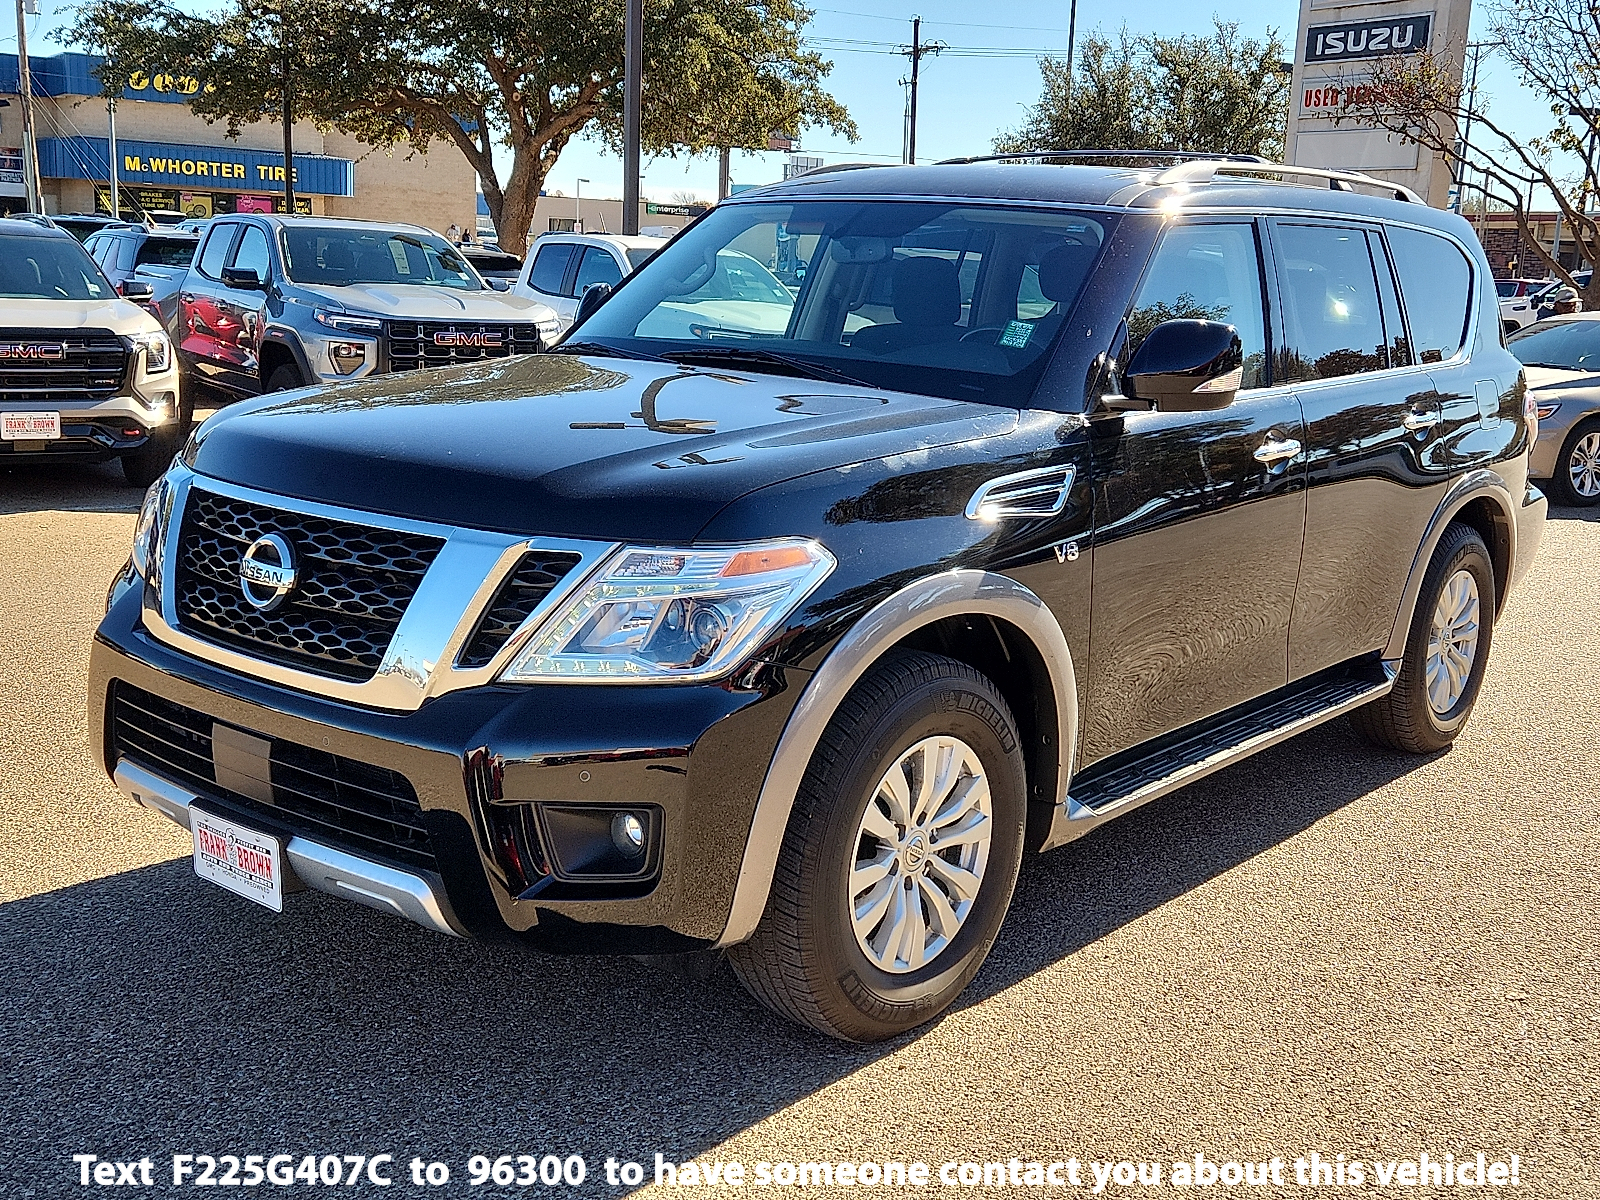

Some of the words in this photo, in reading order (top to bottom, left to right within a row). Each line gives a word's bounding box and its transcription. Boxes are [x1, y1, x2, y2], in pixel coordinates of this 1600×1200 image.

[1315, 25, 1414, 56] ISUZU
[1304, 86, 1339, 108] USED
[124, 155, 246, 179] McWHORTER
[257, 165, 298, 182] TIRE
[434, 331, 503, 347] GMC
[1053, 541, 1079, 564] V8
[241, 560, 283, 583] NISSAN
[957, 692, 1014, 751] MICHELIN
[198, 828, 228, 861] FRANK
[237, 846, 273, 881] BROWN
